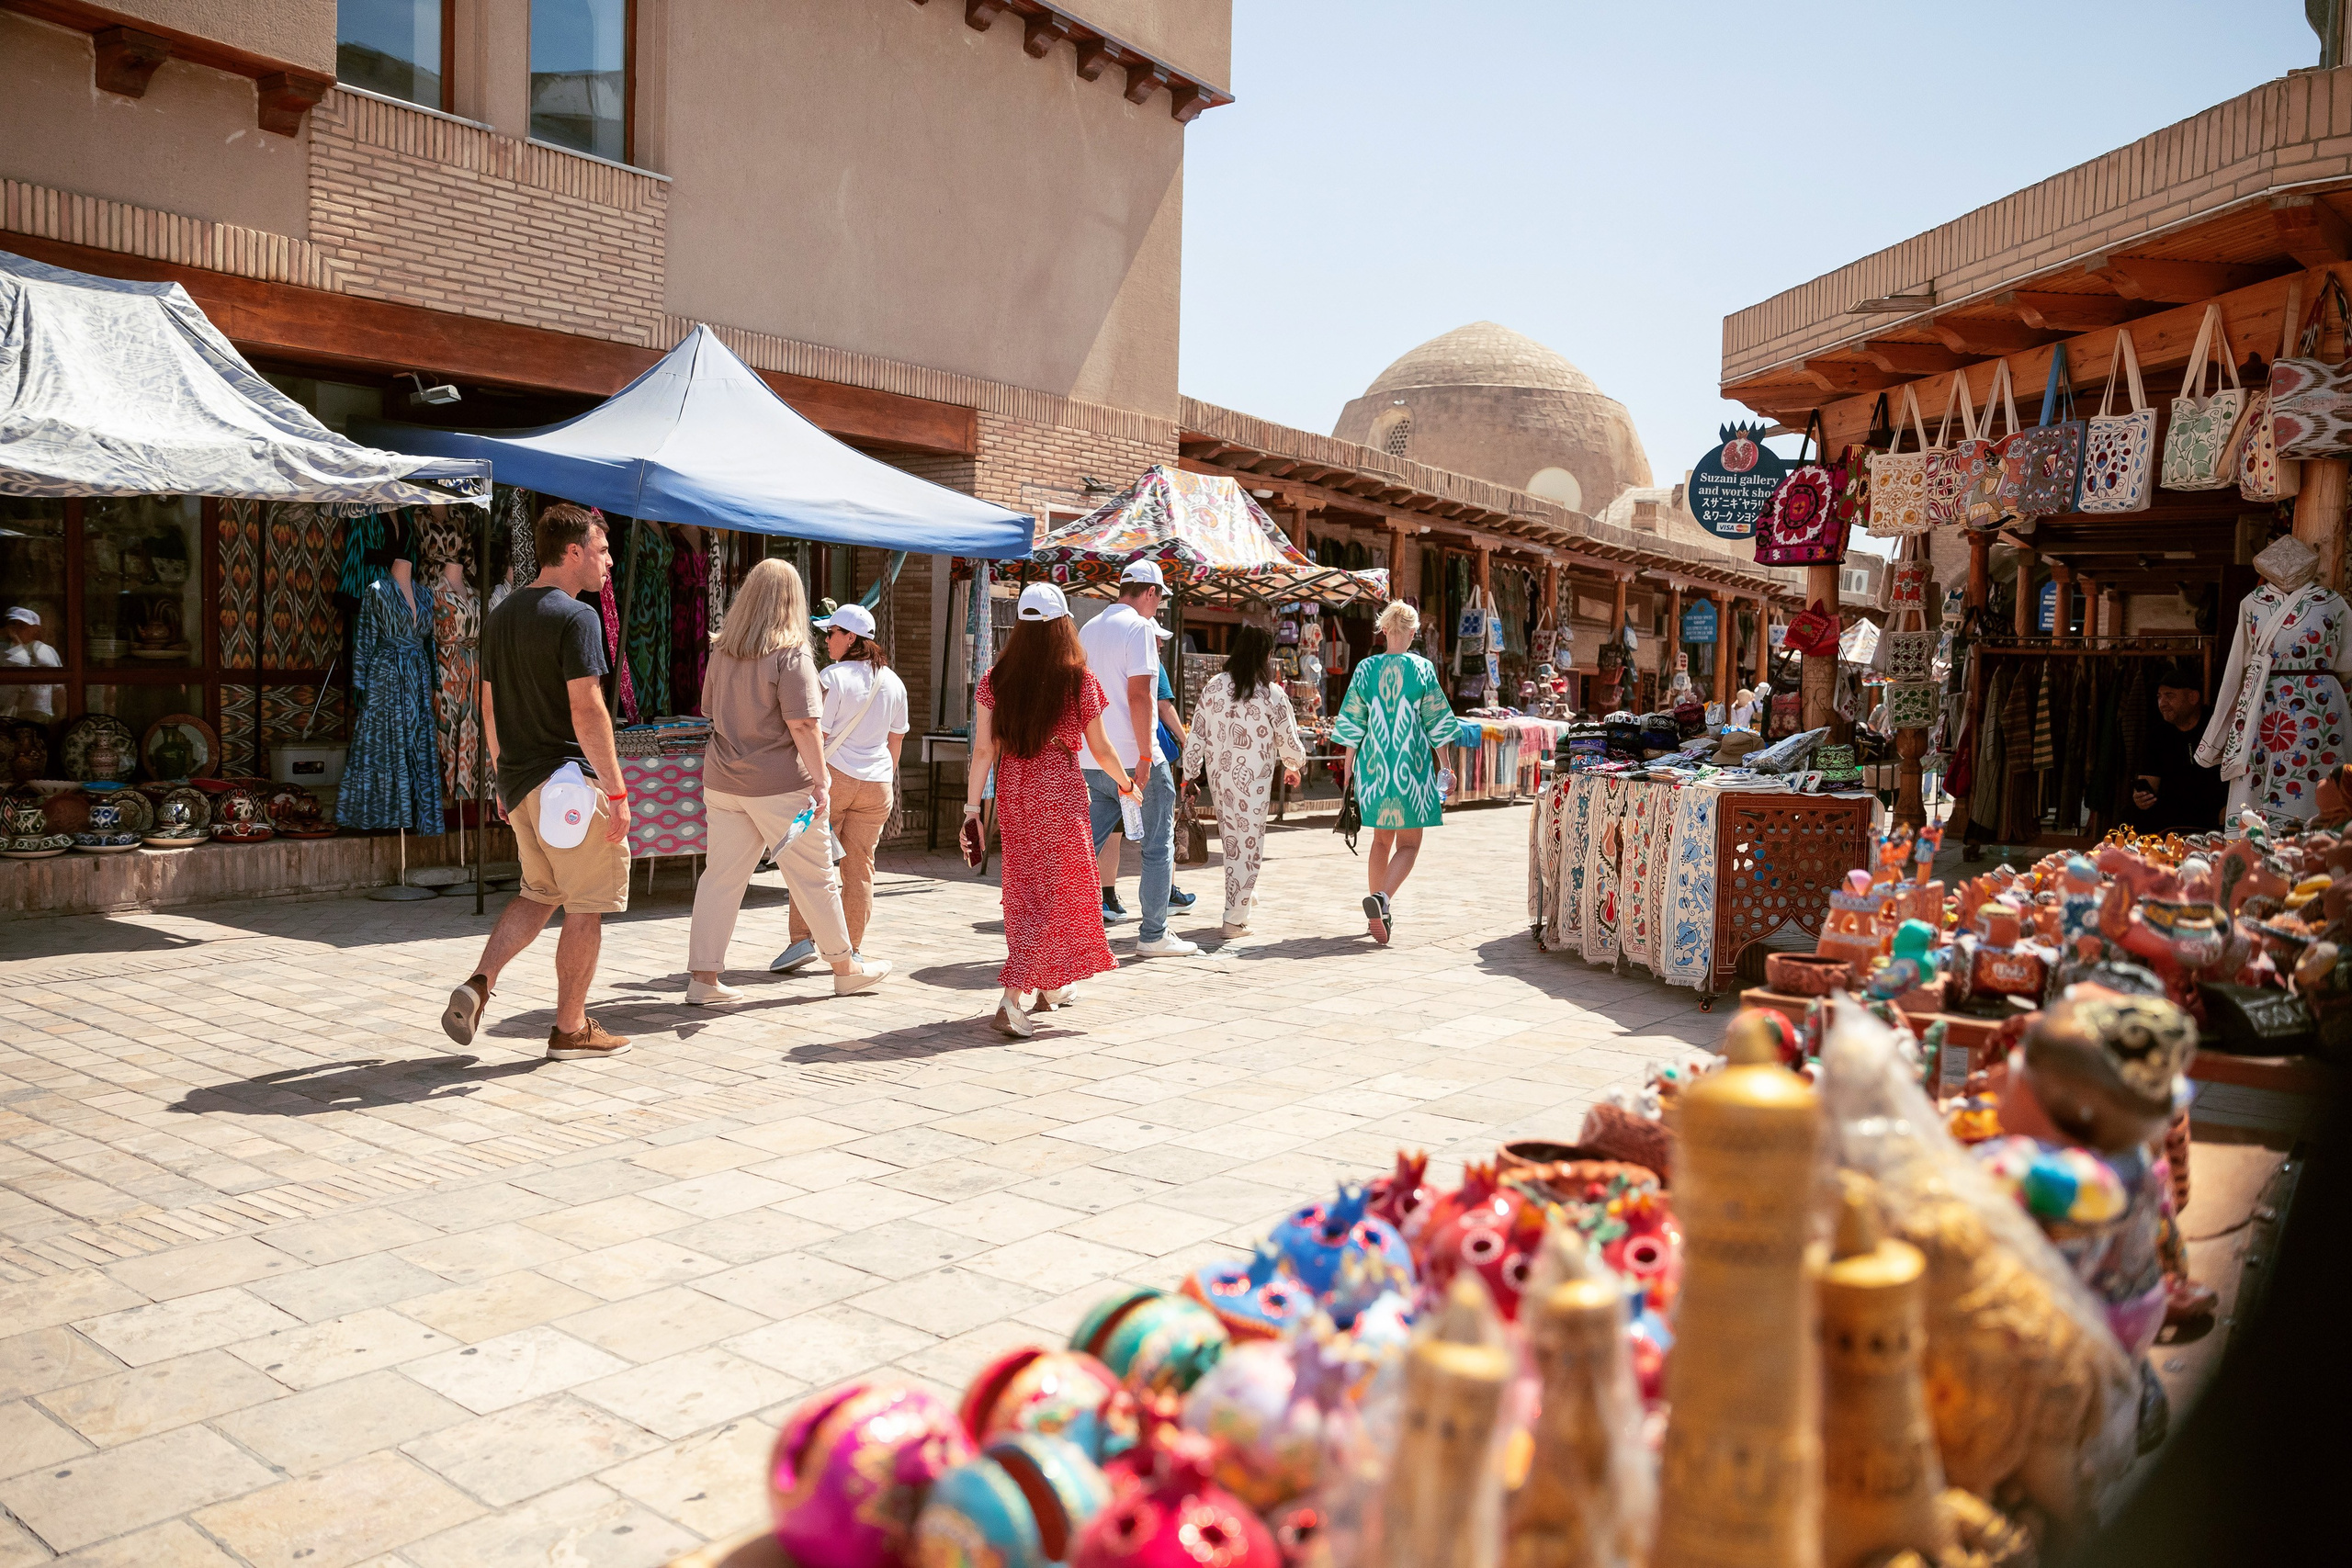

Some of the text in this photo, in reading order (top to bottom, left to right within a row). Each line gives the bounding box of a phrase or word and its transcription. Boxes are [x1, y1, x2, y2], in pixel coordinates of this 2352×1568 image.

[1700, 472, 1779, 488] Suzani gallery
[1698, 486, 1774, 498] and work sho
